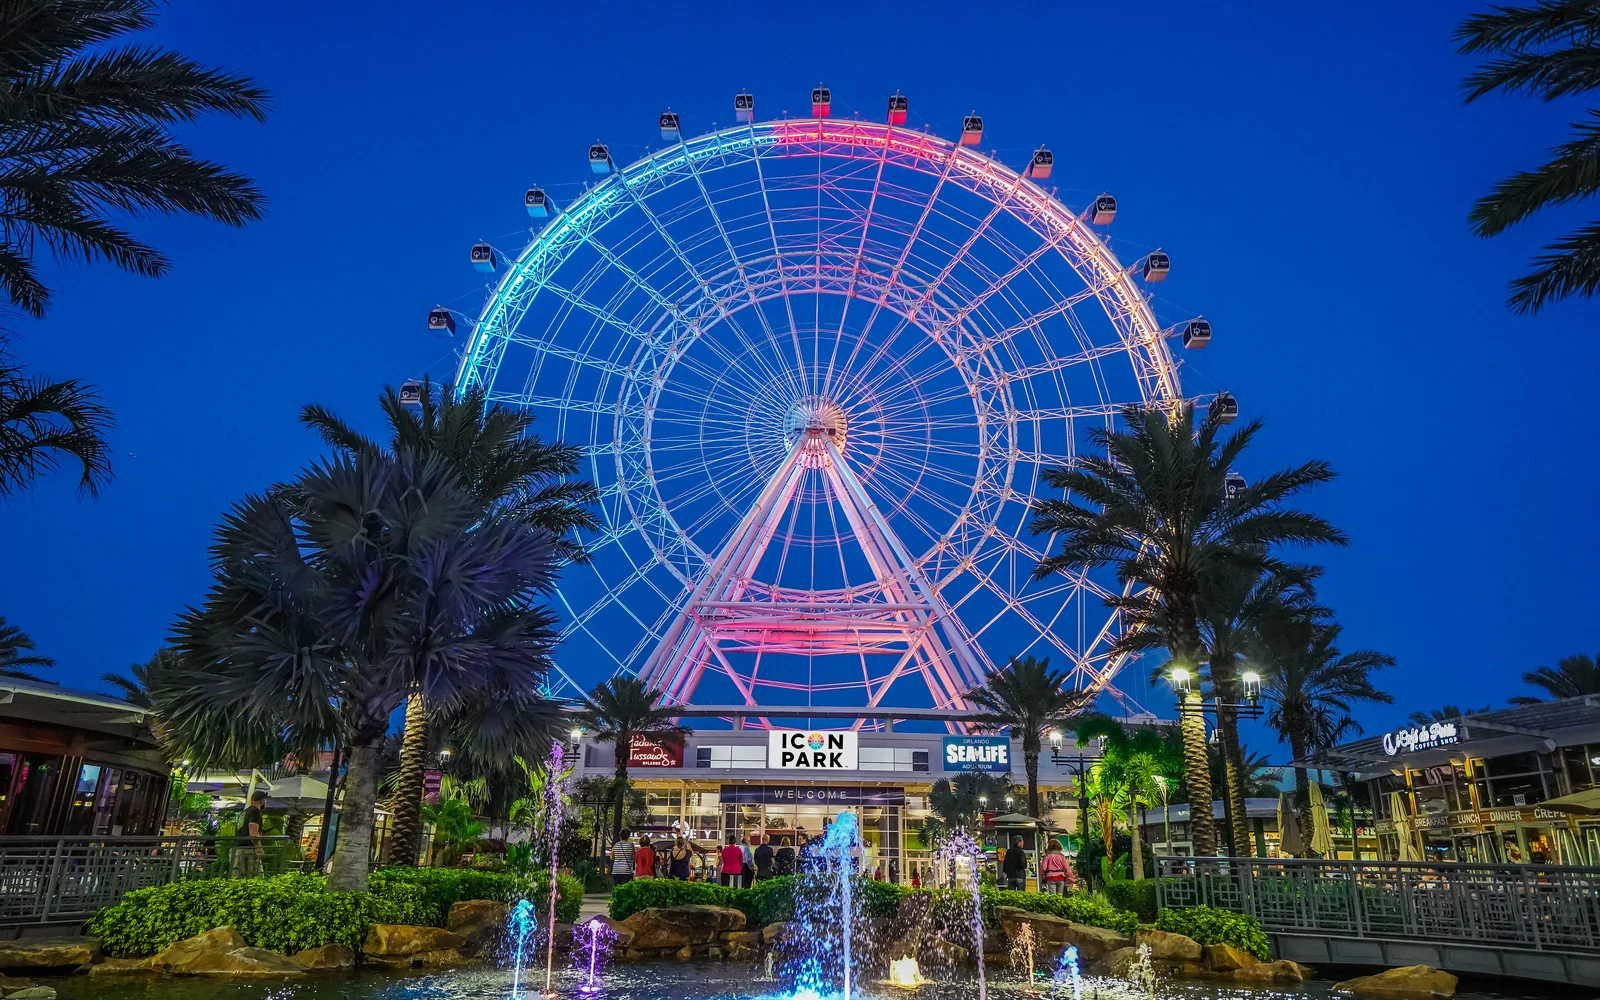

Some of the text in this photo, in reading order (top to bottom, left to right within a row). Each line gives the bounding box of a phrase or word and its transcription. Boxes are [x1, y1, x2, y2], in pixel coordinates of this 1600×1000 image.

[782, 733, 843, 750] ICON
[1414, 736, 1458, 750] COFFEE SHOP
[629, 746, 669, 766] Tussauds
[782, 752, 843, 768] PARK
[947, 744, 976, 763] SEA
[774, 790, 847, 799] WELCOME
[1415, 816, 1449, 828] BREAKFAST
[1457, 813, 1480, 824] LUNCH
[1489, 810, 1522, 822] DINNER
